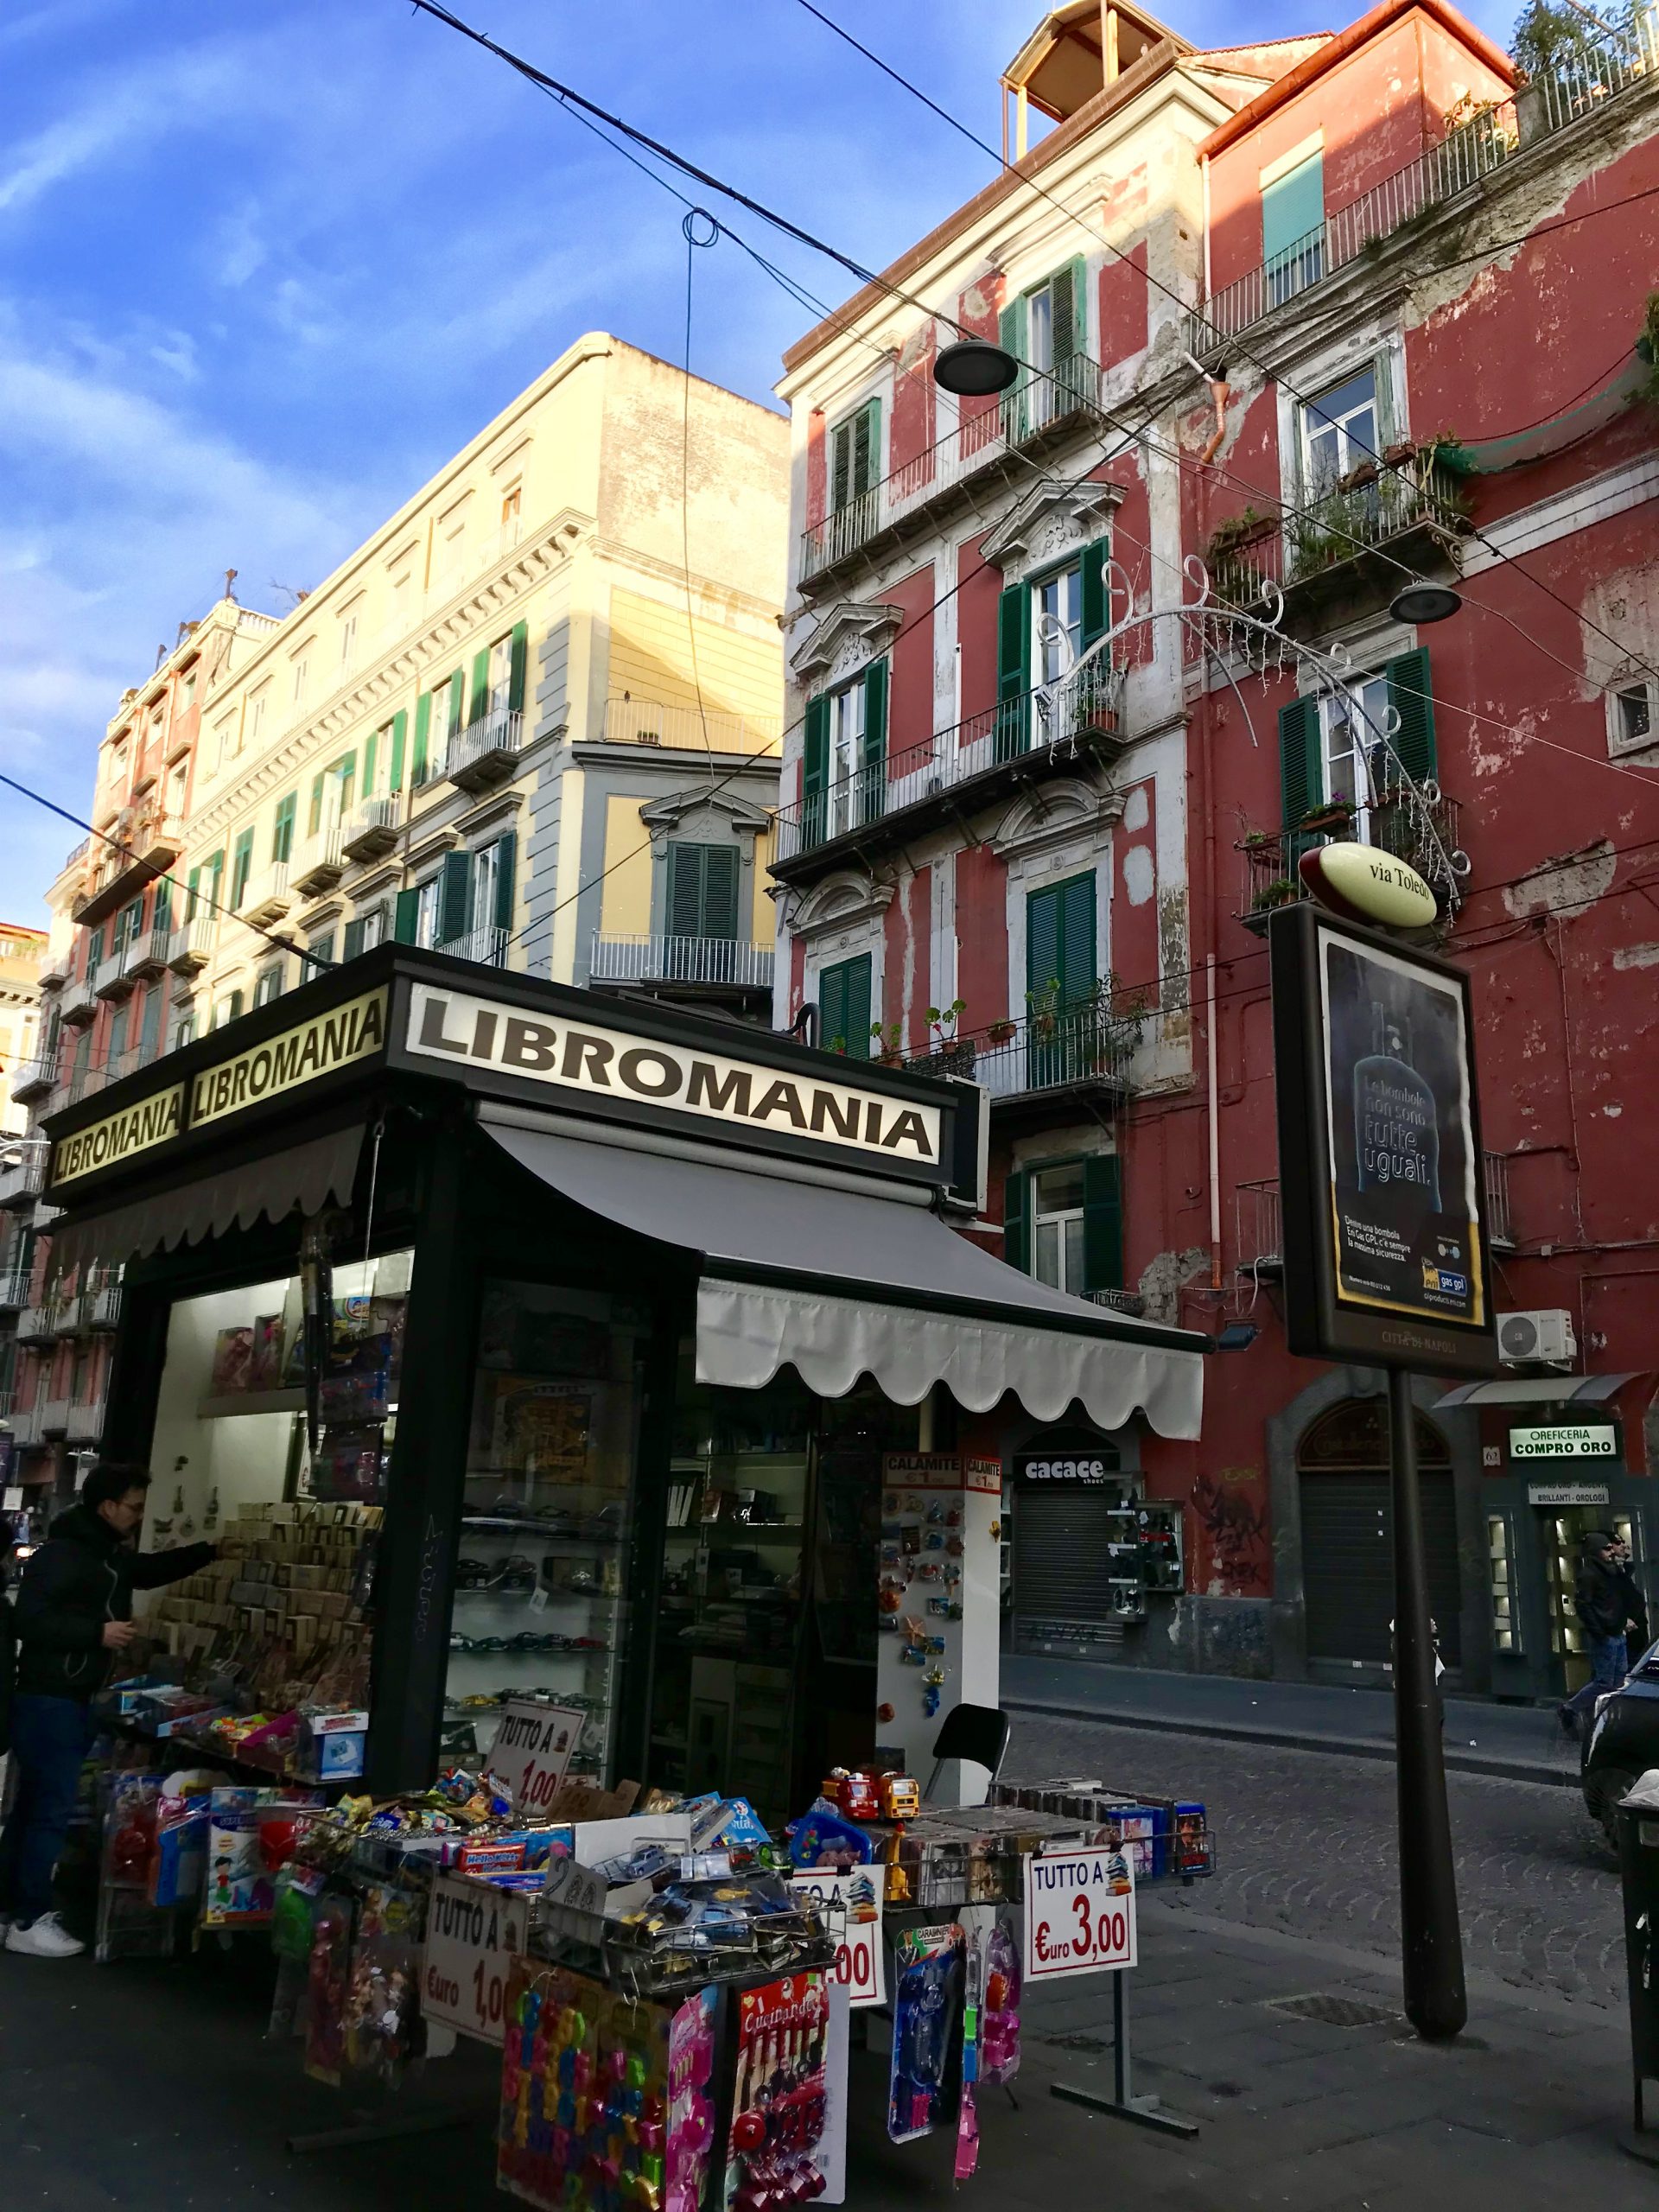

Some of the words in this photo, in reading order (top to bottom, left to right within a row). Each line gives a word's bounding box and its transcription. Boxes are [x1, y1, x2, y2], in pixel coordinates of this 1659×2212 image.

[1370, 862, 1392, 883] via
[1395, 868, 1429, 900] Toledo
[193, 997, 385, 1122] LIBROMANIA
[419, 997, 933, 1156] LIBROMANIA
[1381, 1080, 1425, 1108] bombole
[1365, 1096, 1391, 1117] non
[1395, 1105, 1426, 1126] sono
[54, 1091, 181, 1179] LIBROMANIA
[1365, 1115, 1418, 1156] tutte
[1348, 1236, 1354, 1247] la
[1354, 1241, 1375, 1255] massima
[1363, 1224, 1374, 1233] una
[1374, 1225, 1400, 1241] bombola
[1365, 1233, 1378, 1245] GPL
[1389, 1241, 1411, 1254] sempre
[1426, 1277, 1439, 1289] eni
[1441, 1276, 1452, 1287] gas
[1453, 1278, 1464, 1291] gpl
[1515, 1443, 1574, 1454] COMPRO
[1580, 1441, 1611, 1452] ORO
[1530, 1429, 1590, 1440] OREFICERIA
[888, 1457, 959, 1471] CALAMITE
[969, 1458, 1001, 1476] CALAMITE
[1025, 1460, 1104, 1479] cacace
[500, 1715, 542, 1751] TUTTO
[539, 1723, 555, 1753] A
[518, 1759, 556, 1809] 1,00
[1034, 1862, 1088, 1891] TUTTO
[1092, 1860, 1103, 1885] A
[435, 1893, 484, 1945] TUTTO
[486, 1909, 498, 1952] A
[1071, 1893, 1125, 1962] 3,00
[474, 1959, 510, 2028] 1,0
